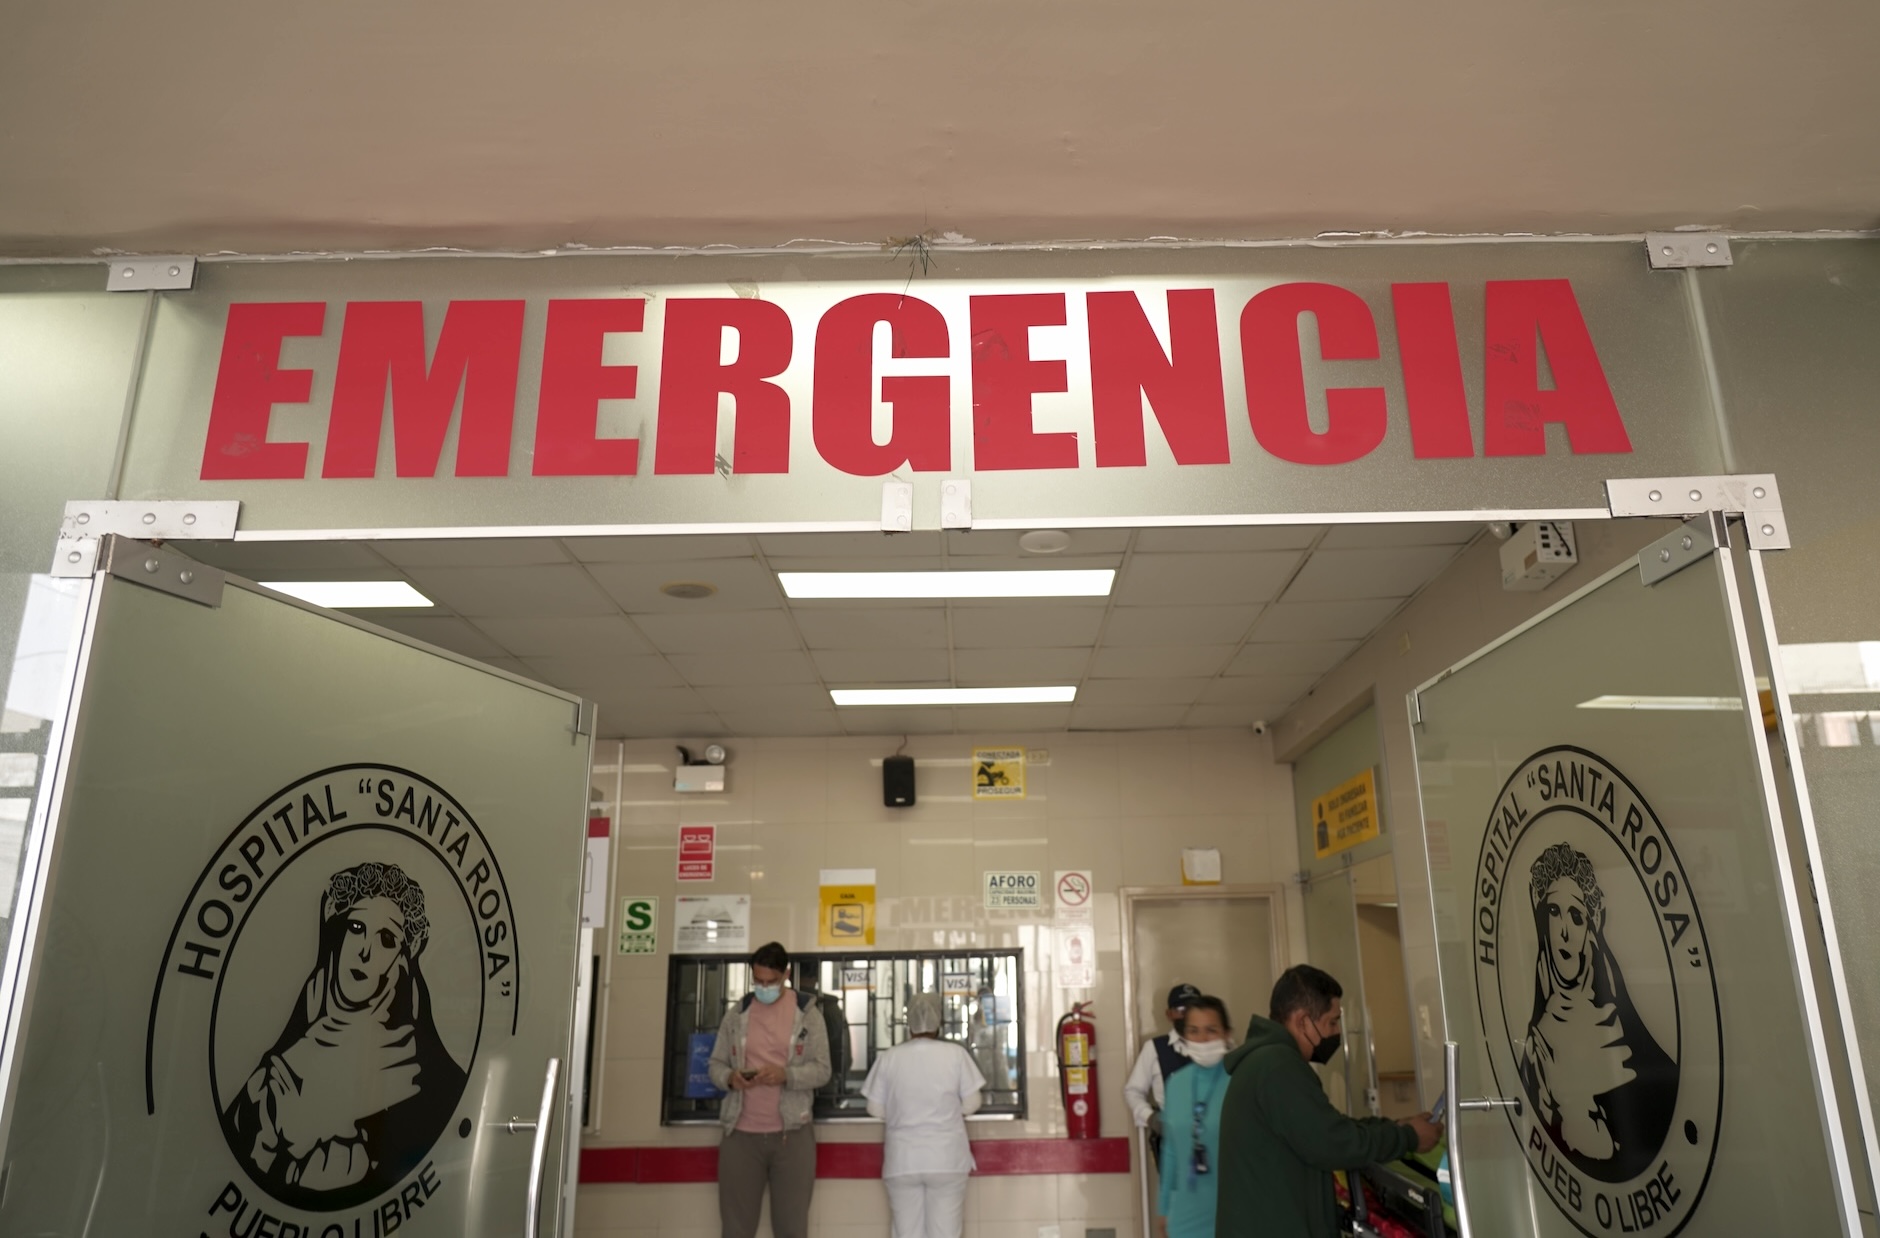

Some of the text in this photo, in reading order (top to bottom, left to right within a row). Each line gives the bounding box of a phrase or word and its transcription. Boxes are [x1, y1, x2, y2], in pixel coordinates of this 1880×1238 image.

[200, 279, 1632, 481] EMERGENCIA
[178, 785, 347, 980] HOSPITAL
[989, 875, 1036, 888] AFORO
[1480, 792, 1528, 967] HOSPITAL
[1003, 896, 1036, 905] PERSONAS
[626, 902, 652, 931] S
[846, 972, 871, 983] VISA
[945, 979, 971, 989] VISA
[1616, 1160, 1682, 1233] LIBRE
